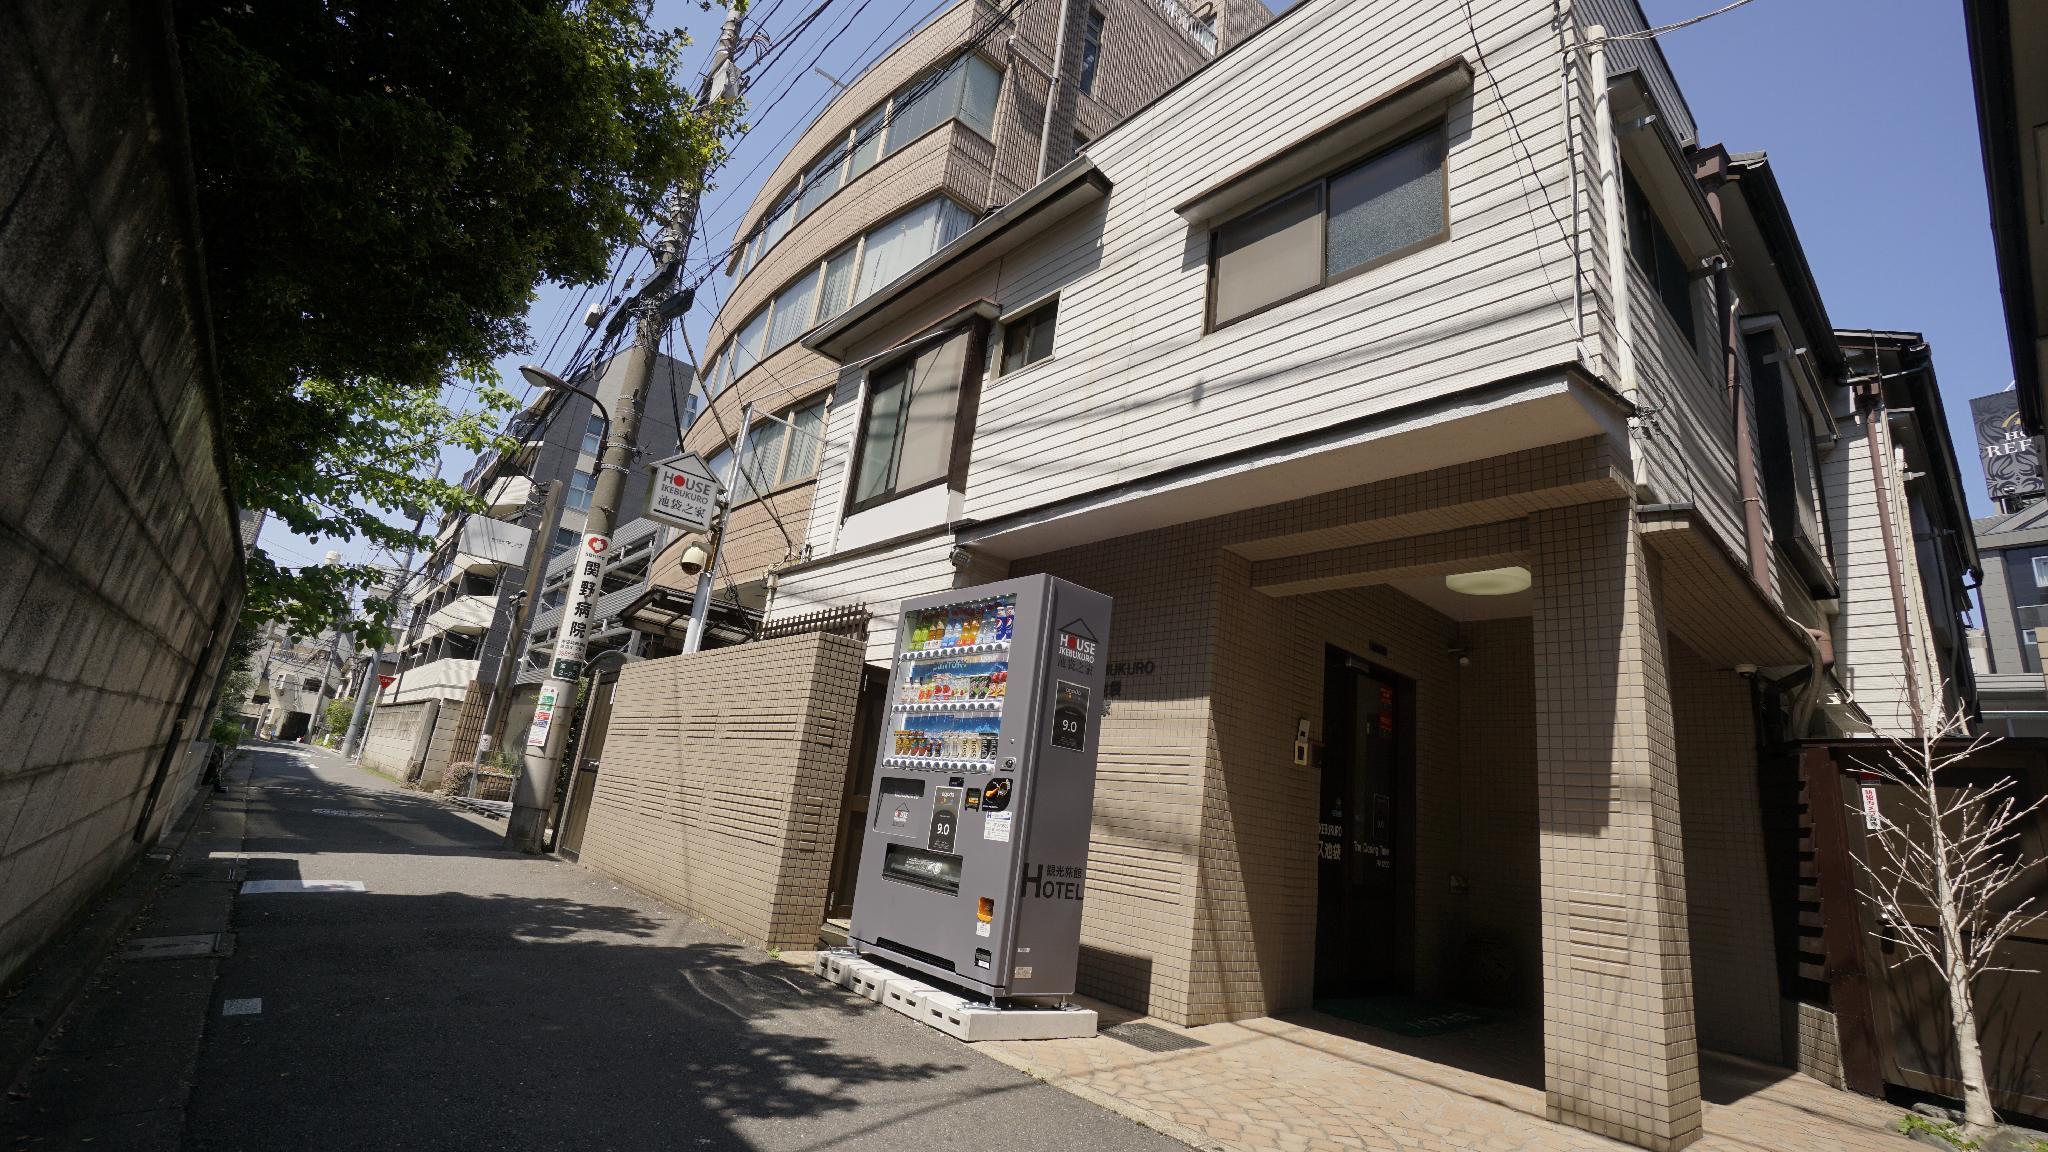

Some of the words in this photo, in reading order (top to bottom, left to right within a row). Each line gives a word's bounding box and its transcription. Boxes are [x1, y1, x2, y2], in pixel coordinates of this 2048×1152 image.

[663, 471, 711, 496] HOUSE
[661, 484, 708, 505] IKEBUKURO
[658, 495, 706, 519] 池袋之家
[569, 560, 600, 638] 関野病院
[1060, 634, 1096, 655] HOUSE
[1059, 647, 1095, 664] IKEBUKURO
[1062, 720, 1078, 733] 9.0
[937, 823, 950, 836] 9.0
[1021, 863, 1084, 900] HOTEL
[1047, 864, 1083, 879] 観光旅館
